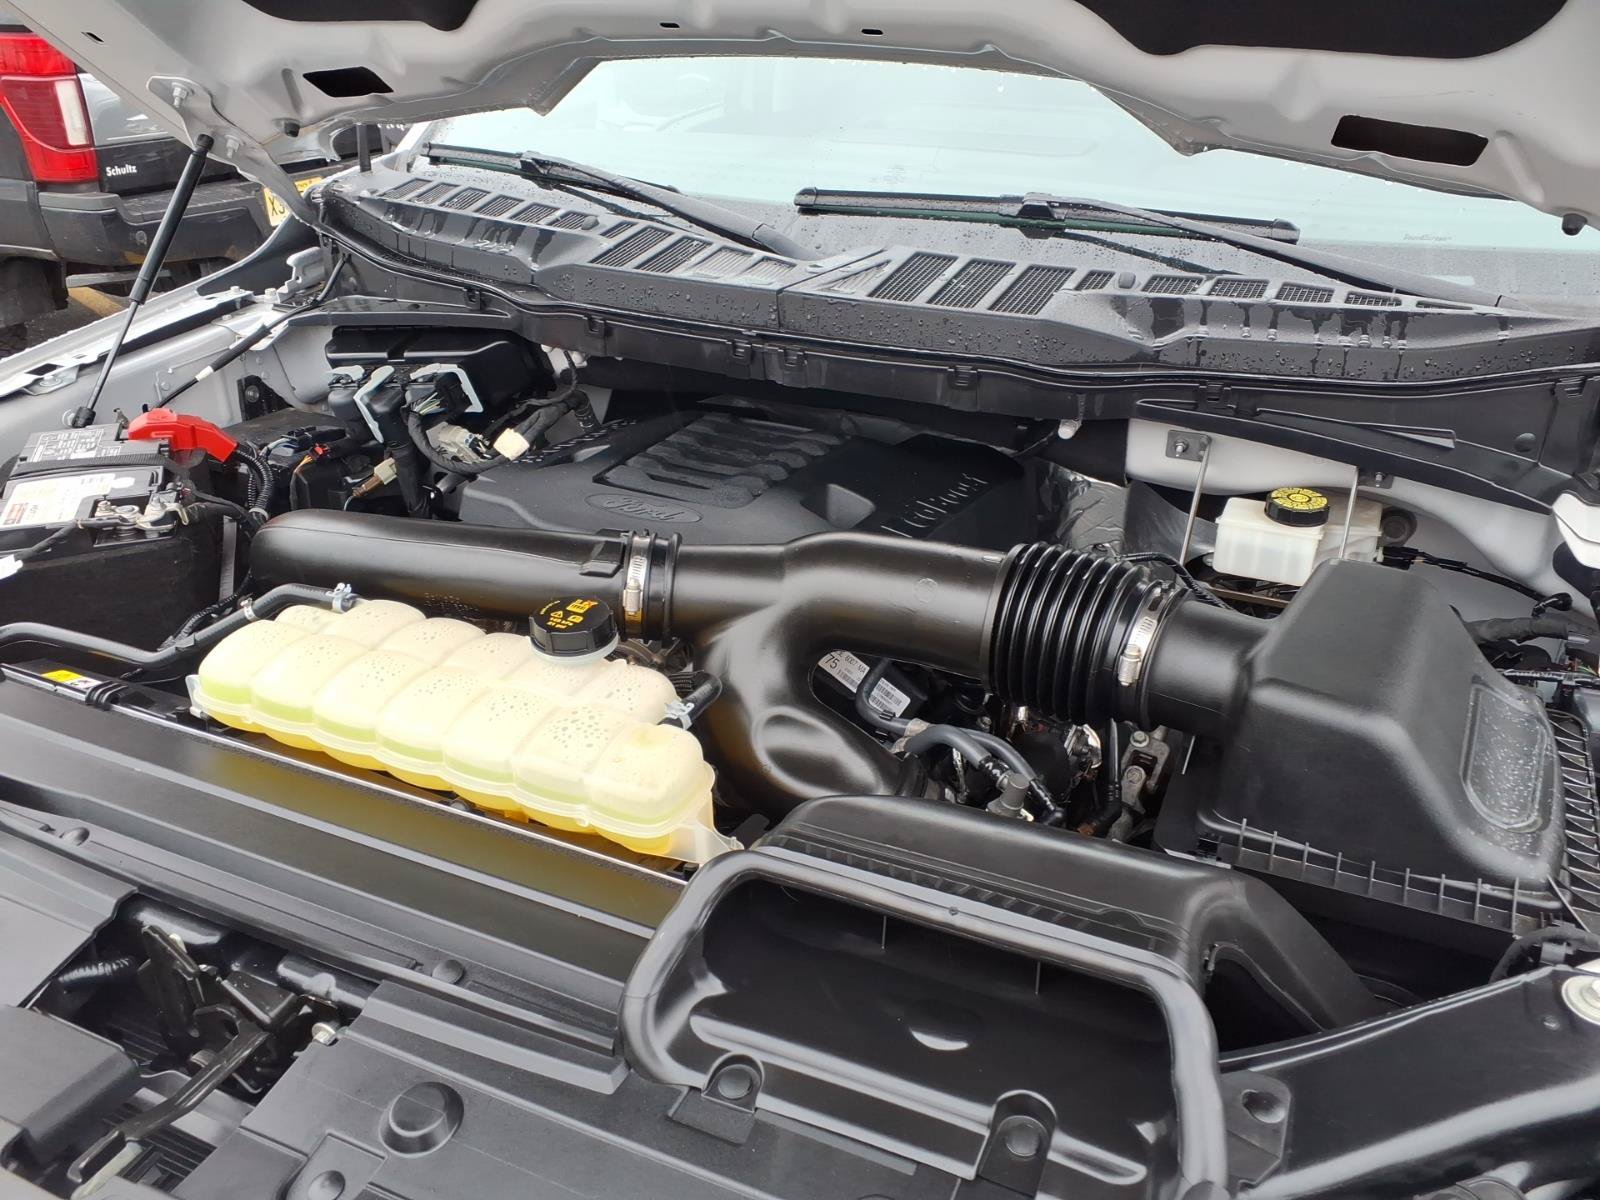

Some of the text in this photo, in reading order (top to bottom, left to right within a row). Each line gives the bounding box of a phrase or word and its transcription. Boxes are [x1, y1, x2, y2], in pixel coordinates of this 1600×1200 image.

[105, 163, 138, 177] Schultz
[600, 497, 685, 521] Ford
[824, 652, 840, 670] 75
